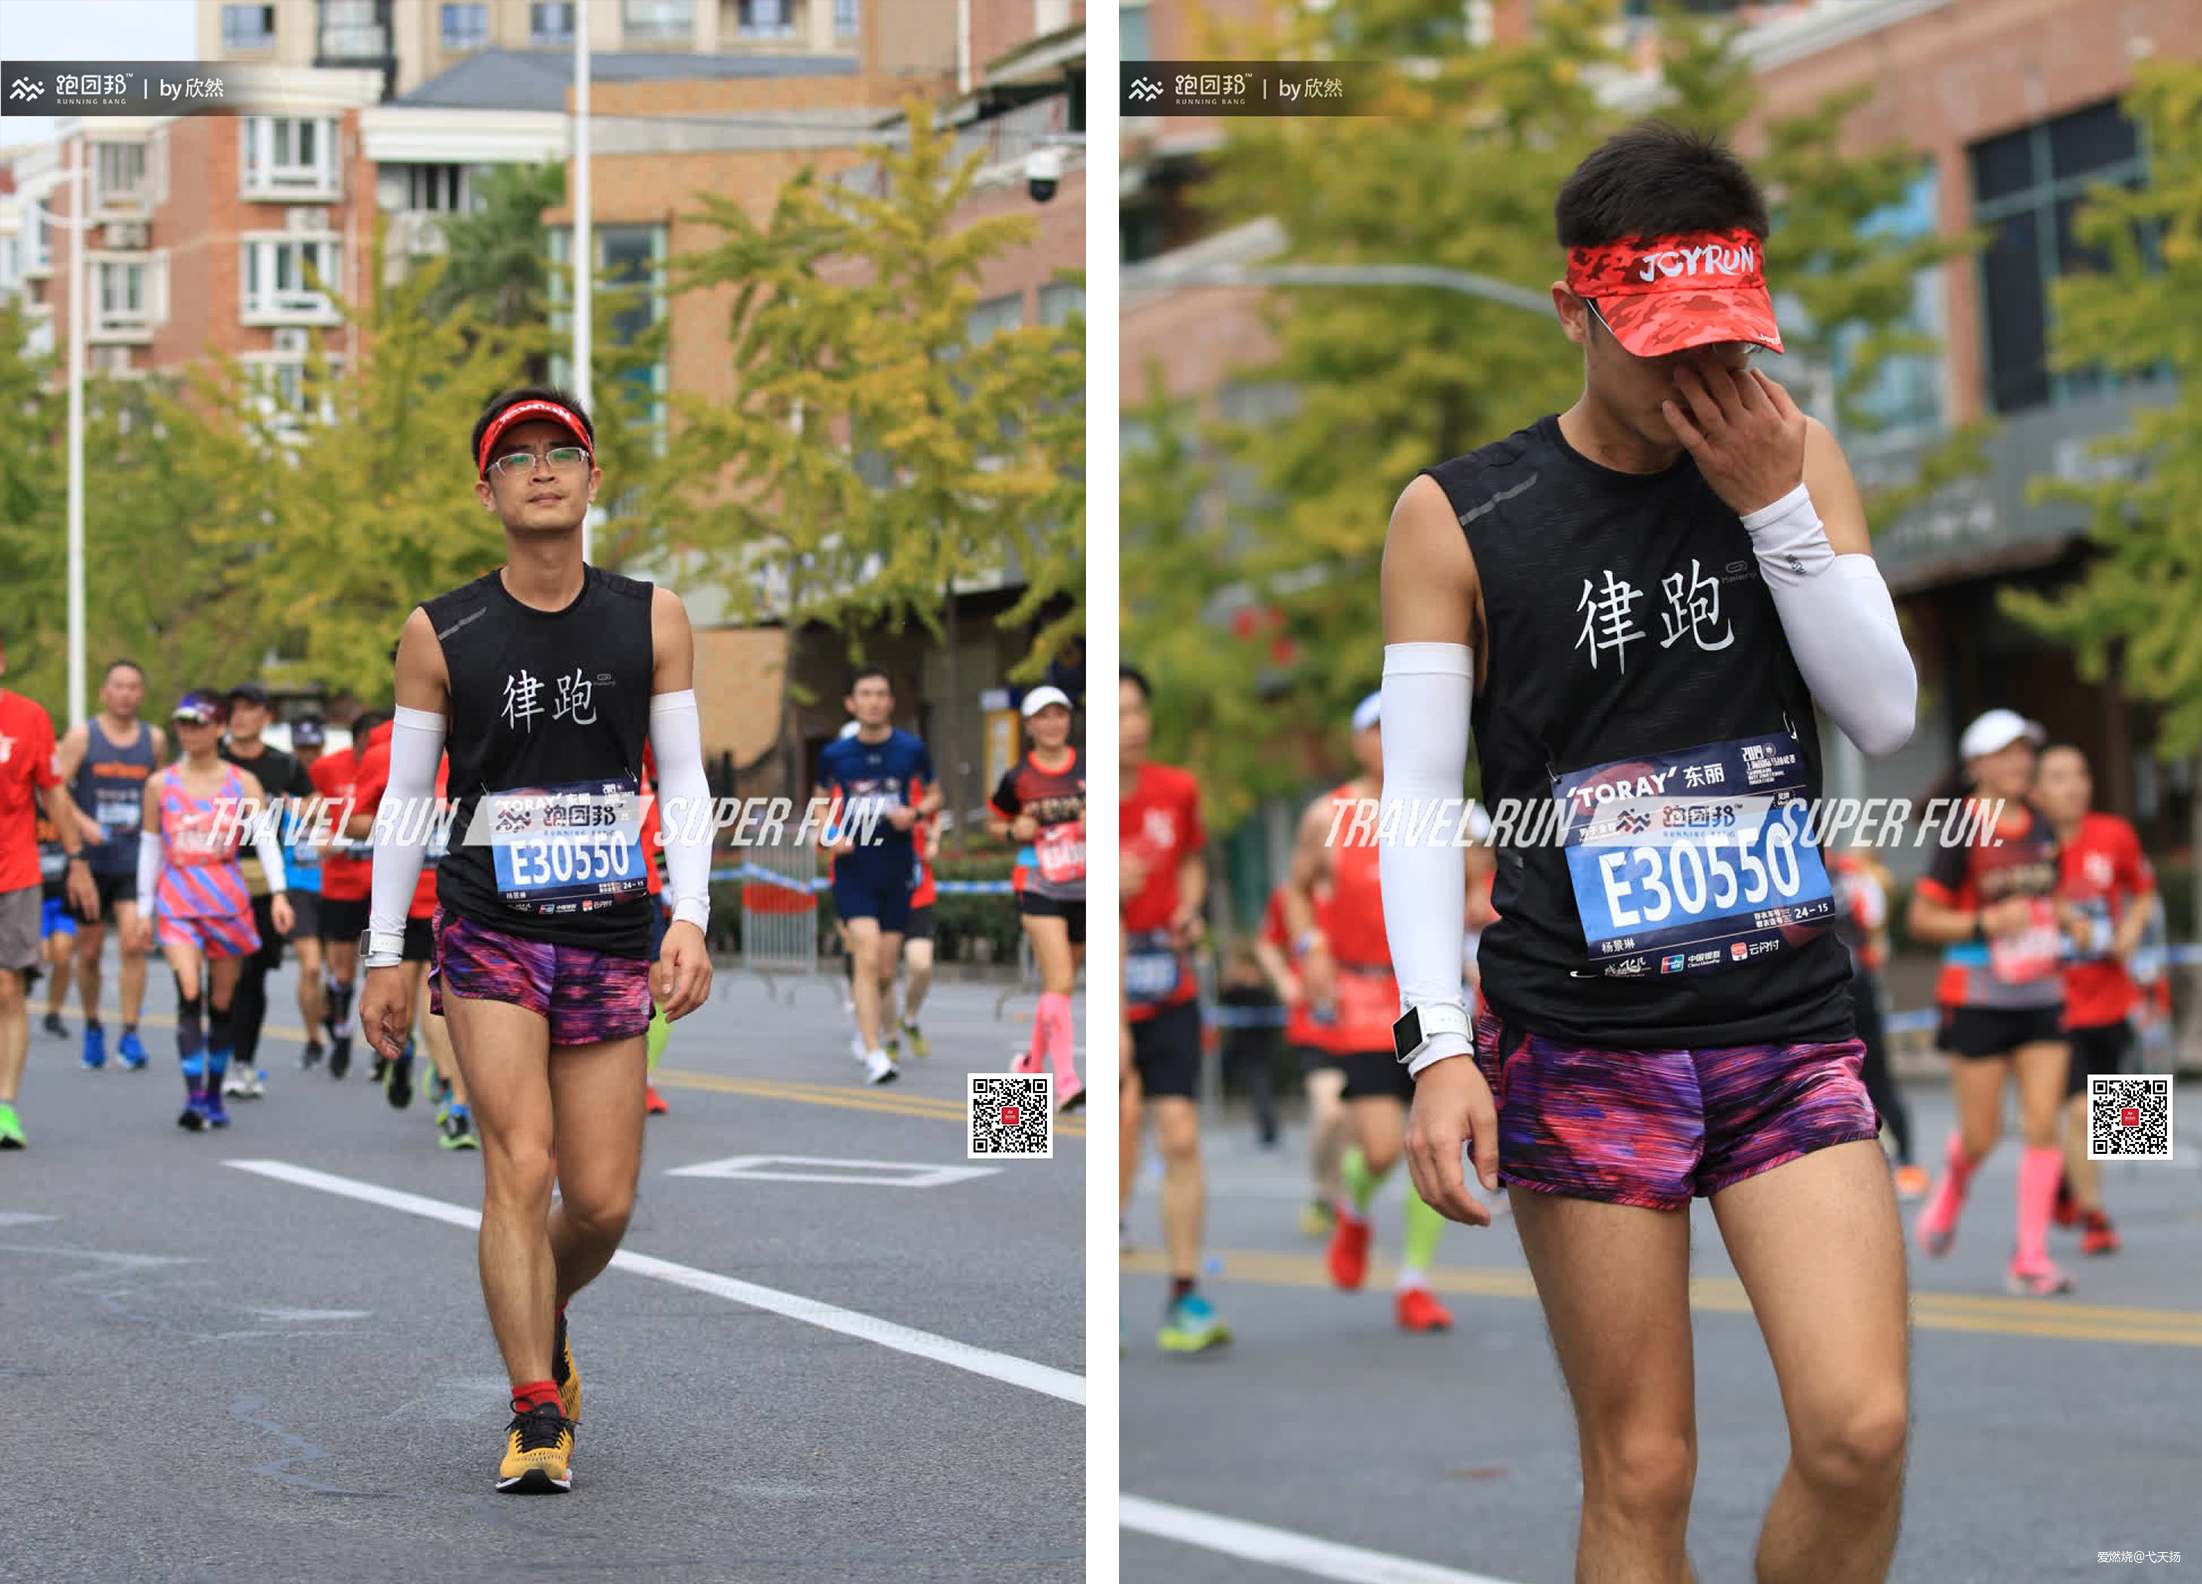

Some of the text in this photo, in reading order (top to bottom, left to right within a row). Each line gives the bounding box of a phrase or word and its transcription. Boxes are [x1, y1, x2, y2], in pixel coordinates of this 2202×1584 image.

[1574, 558, 1735, 676] 律跑
[500, 667, 598, 734] 律跑
[1683, 763, 1725, 788] 东丽
[509, 829, 631, 886] E30550
[1598, 822, 1801, 928] E30550
[1748, 939, 1780, 956] 云闪付
